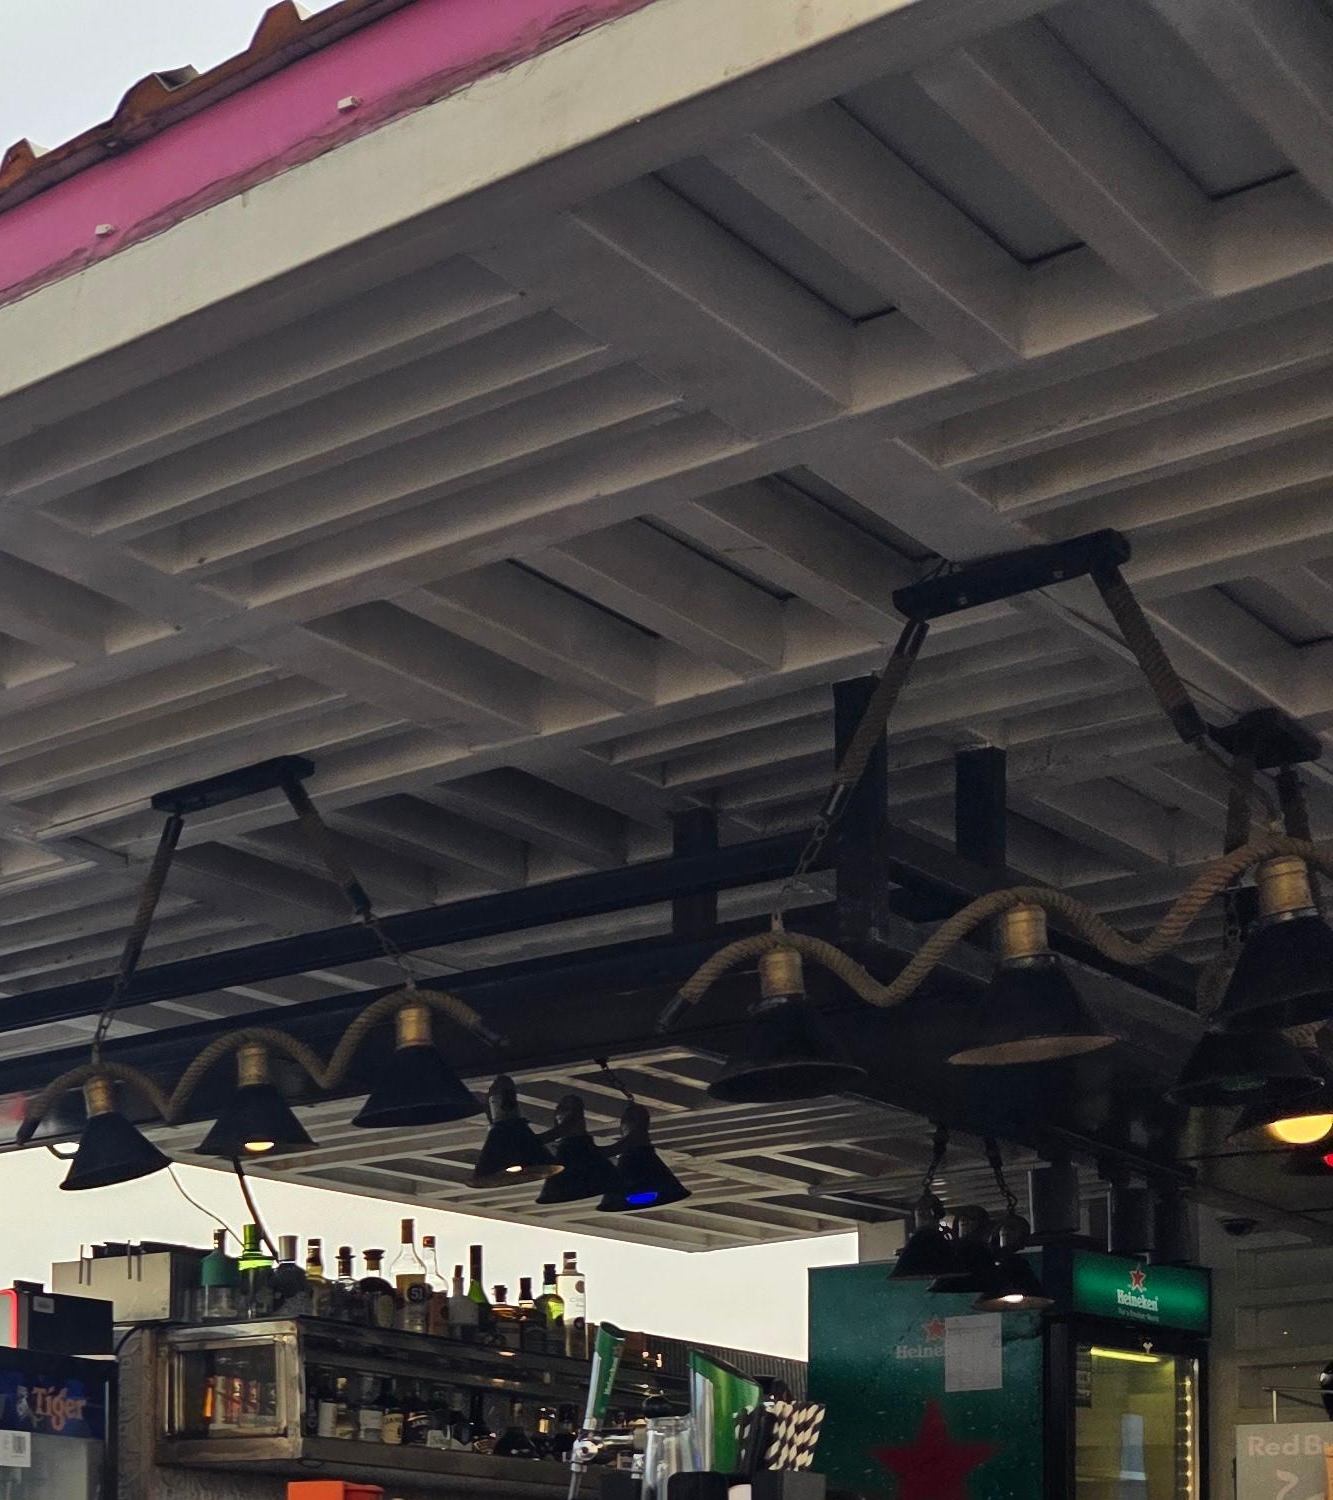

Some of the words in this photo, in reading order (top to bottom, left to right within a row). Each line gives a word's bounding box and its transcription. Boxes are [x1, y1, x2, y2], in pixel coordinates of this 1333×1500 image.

[1117, 1289, 1159, 1312] Heineken
[895, 1344, 945, 1359] Heine
[32, 1386, 86, 1432] Tiger
[1246, 1434, 1300, 1456] Red
